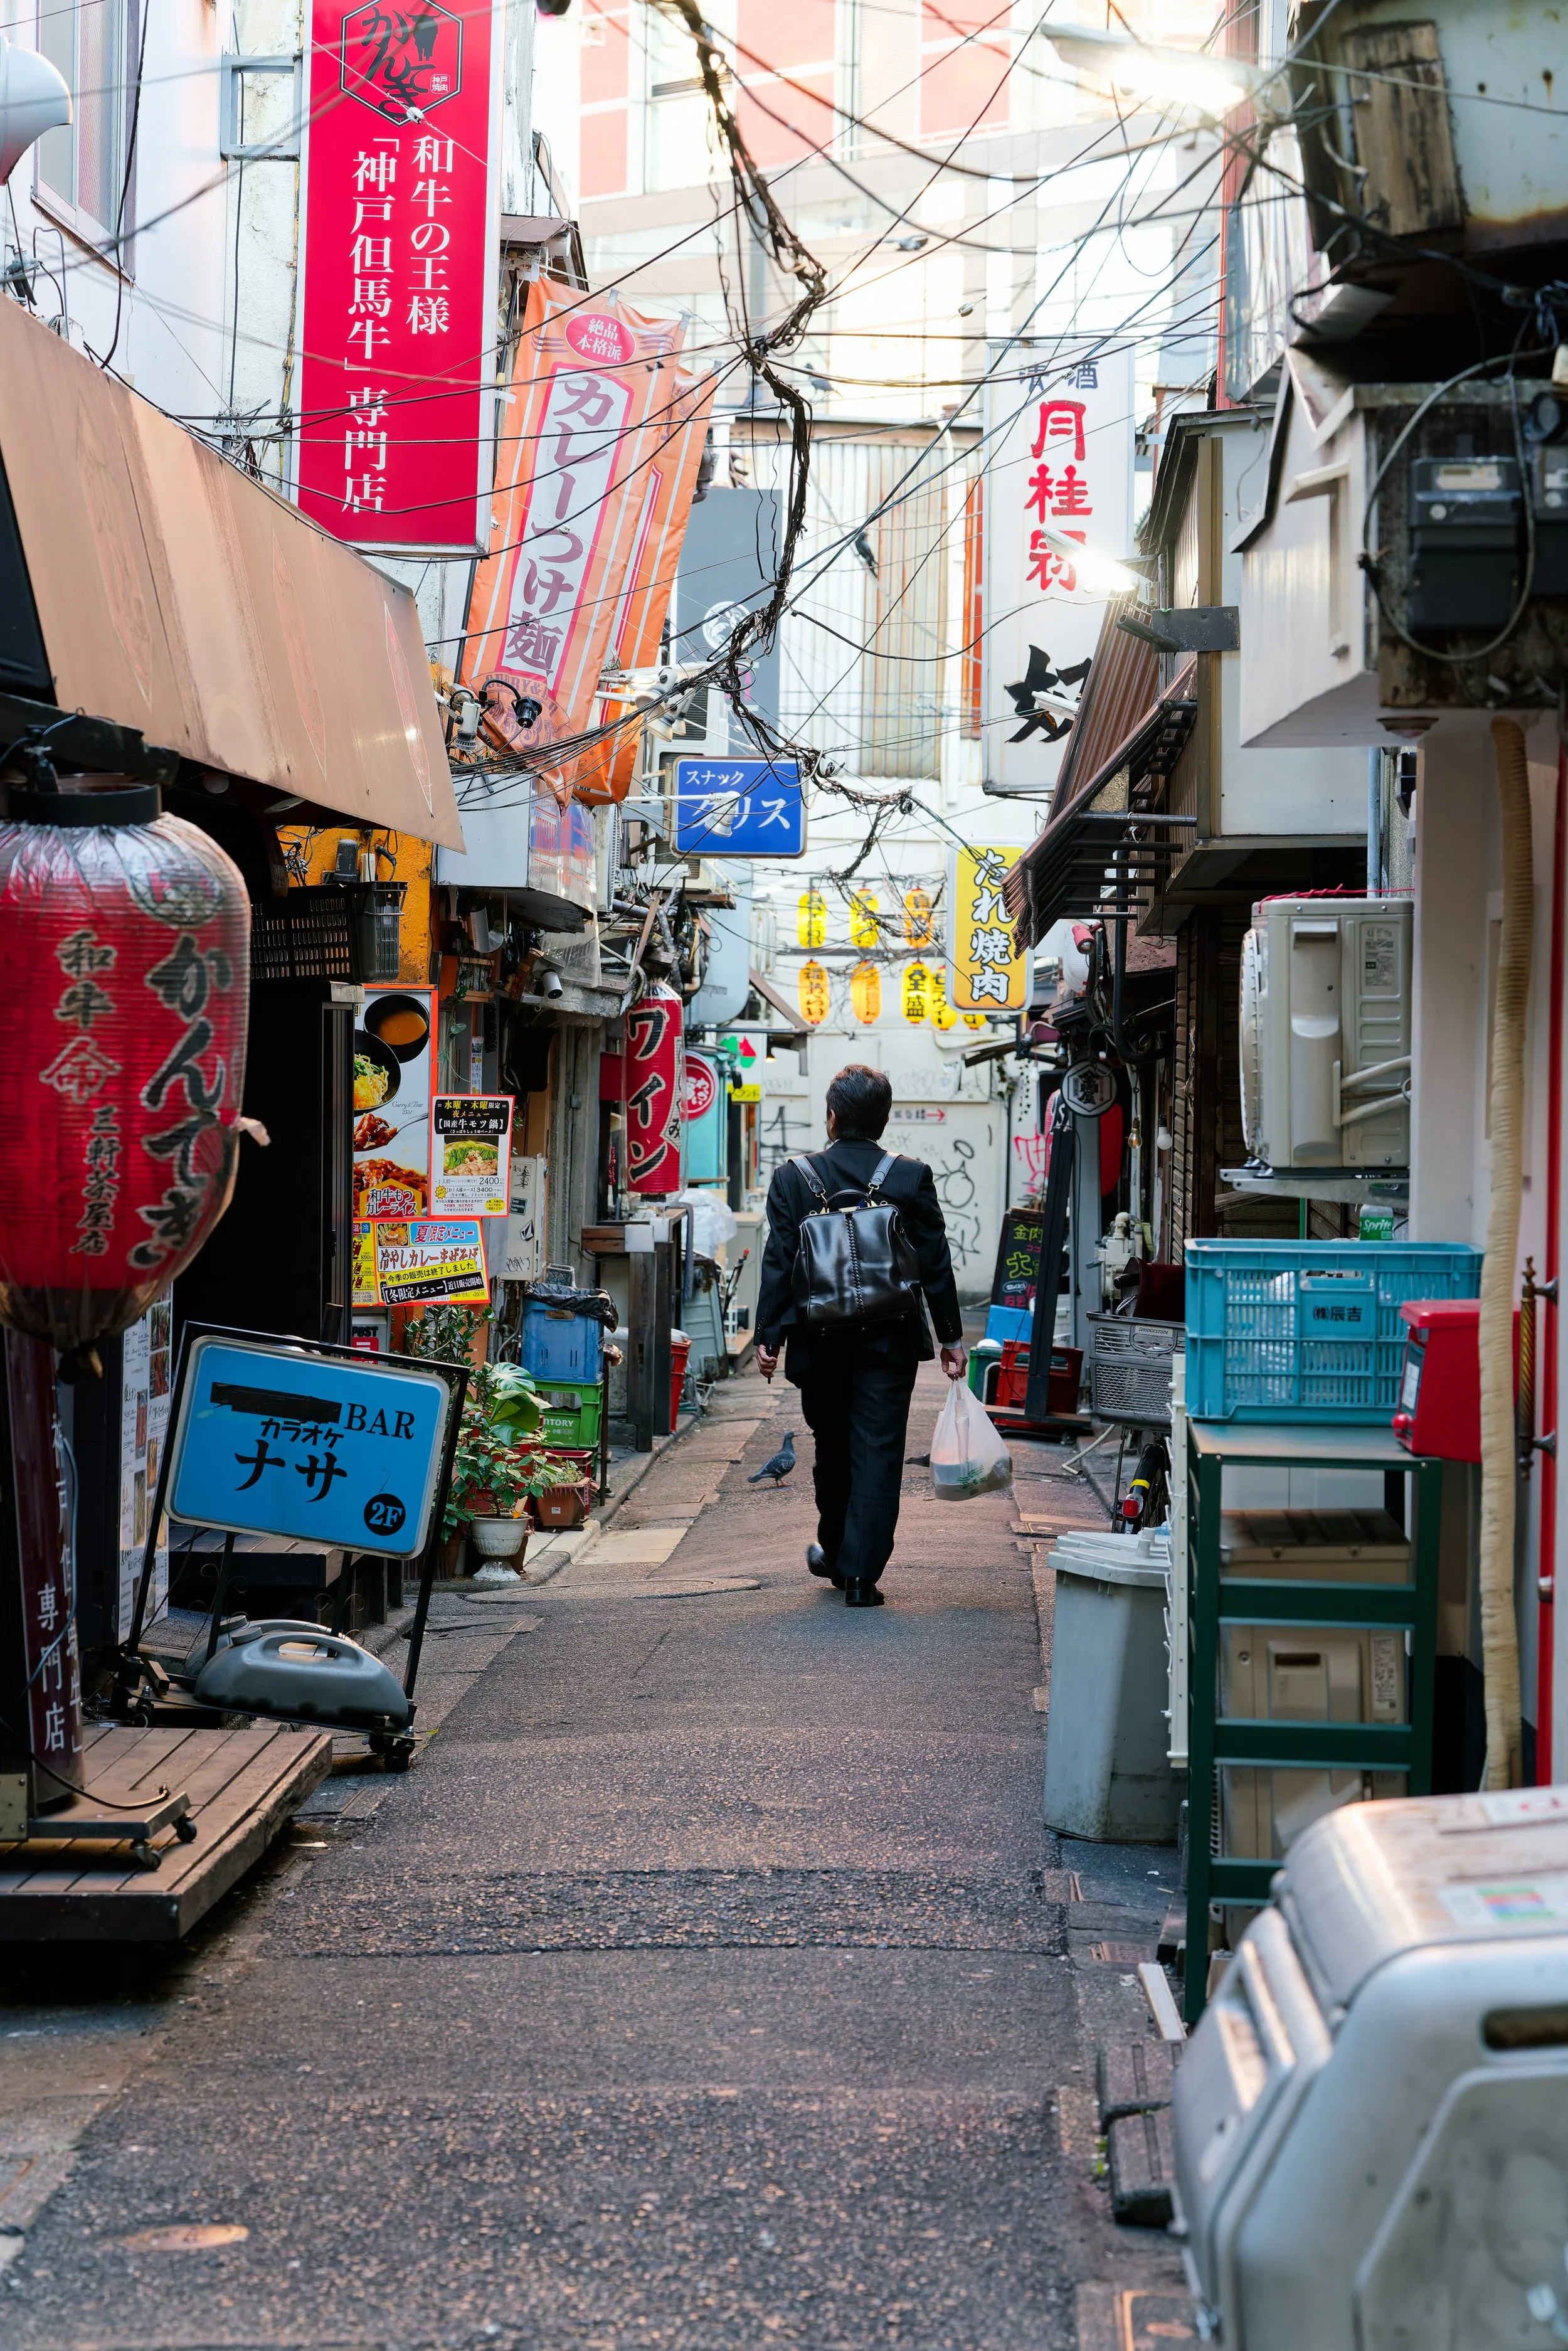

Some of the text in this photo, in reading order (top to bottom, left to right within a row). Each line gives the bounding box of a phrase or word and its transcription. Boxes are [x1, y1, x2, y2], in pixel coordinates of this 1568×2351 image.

[406, 135, 454, 335] 和牛の王様
[341, 137, 399, 515] 「神戸但馬牛」専門店
[587, 317, 618, 341] 絶品
[576, 334, 623, 362] 本格派
[1019, 361, 1099, 393] 清酒
[505, 375, 615, 676] カレーつけ麺
[686, 770, 745, 786] スナック
[970, 848, 1012, 1005] たれ焼肉
[444, 1100, 501, 1110] 水曜・木曜限定
[627, 1006, 670, 1184] ワイン
[438, 1118, 504, 1130] 【国産牛モツ鍋】
[452, 1110, 490, 1118] 夜メニュー
[69, 1105, 124, 1257] 三軒茶屋店
[479, 1177, 499, 1185] 2400
[369, 1188, 413, 1203] 和牛もつ
[365, 1201, 418, 1216] カレーライス
[414, 1224, 474, 1243] 夏限定メニュー
[1363, 1219, 1392, 1233] Sprite
[388, 1262, 474, 1283] 今季の販売は終了しました
[384, 1276, 482, 1303] 【冬限定メニュー】近日販売開始
[352, 1325, 379, 1337] POST
[1138, 1327, 1170, 1335] BRIDGESTONE
[260, 1418, 344, 1449] カラオケ
[343, 1403, 416, 1440] BAR
[233, 1438, 348, 1504] ナサ
[369, 1502, 403, 1527] 2F
[37, 1583, 65, 1753] 専門店
